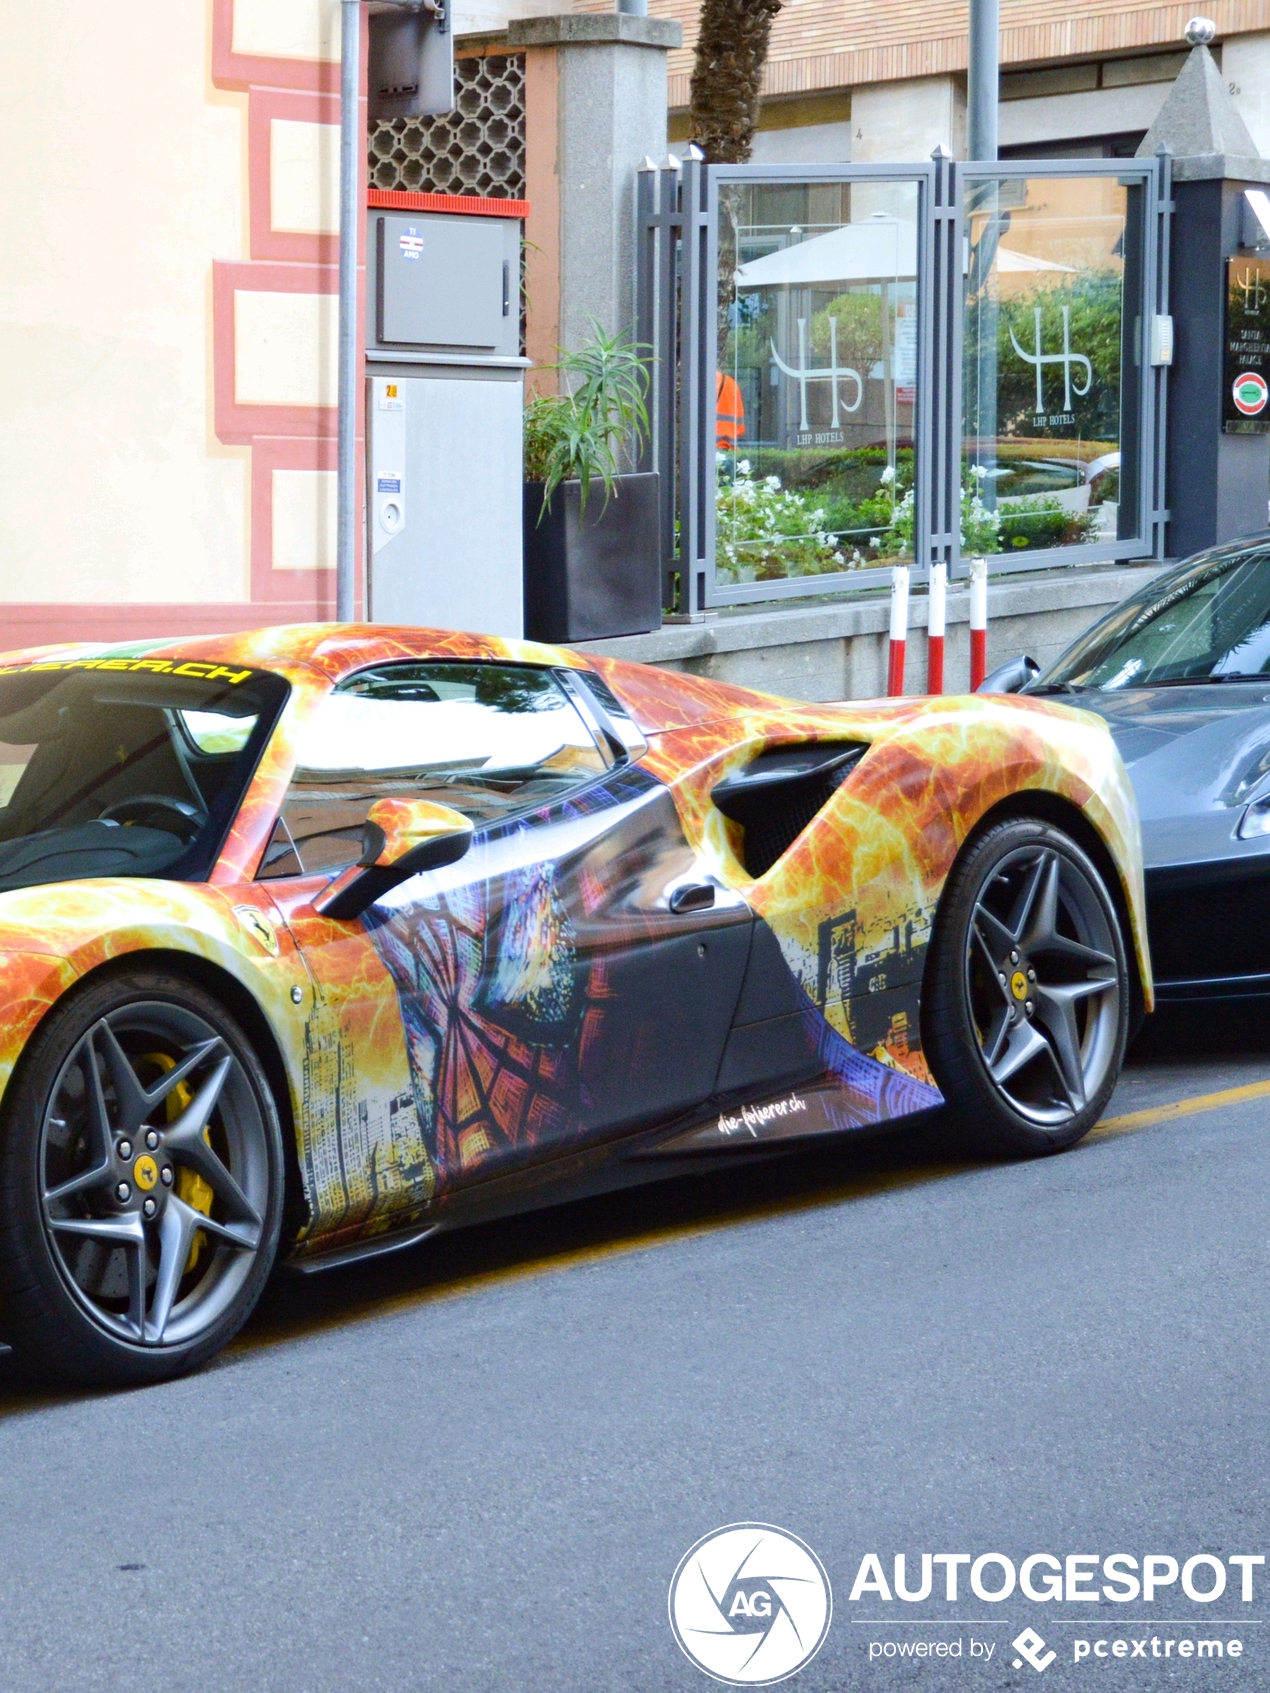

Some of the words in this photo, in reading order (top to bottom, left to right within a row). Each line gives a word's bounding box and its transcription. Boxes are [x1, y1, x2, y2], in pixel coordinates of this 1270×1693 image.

[409, 227, 416, 236] TI
[404, 250, 419, 259] AMO
[1033, 416, 1046, 427] LHP
[1049, 413, 1075, 425] HOTELS
[797, 433, 813, 445] LHP
[815, 431, 844, 444] HOTELS
[718, 1092, 806, 1137] die-folierer.ch
